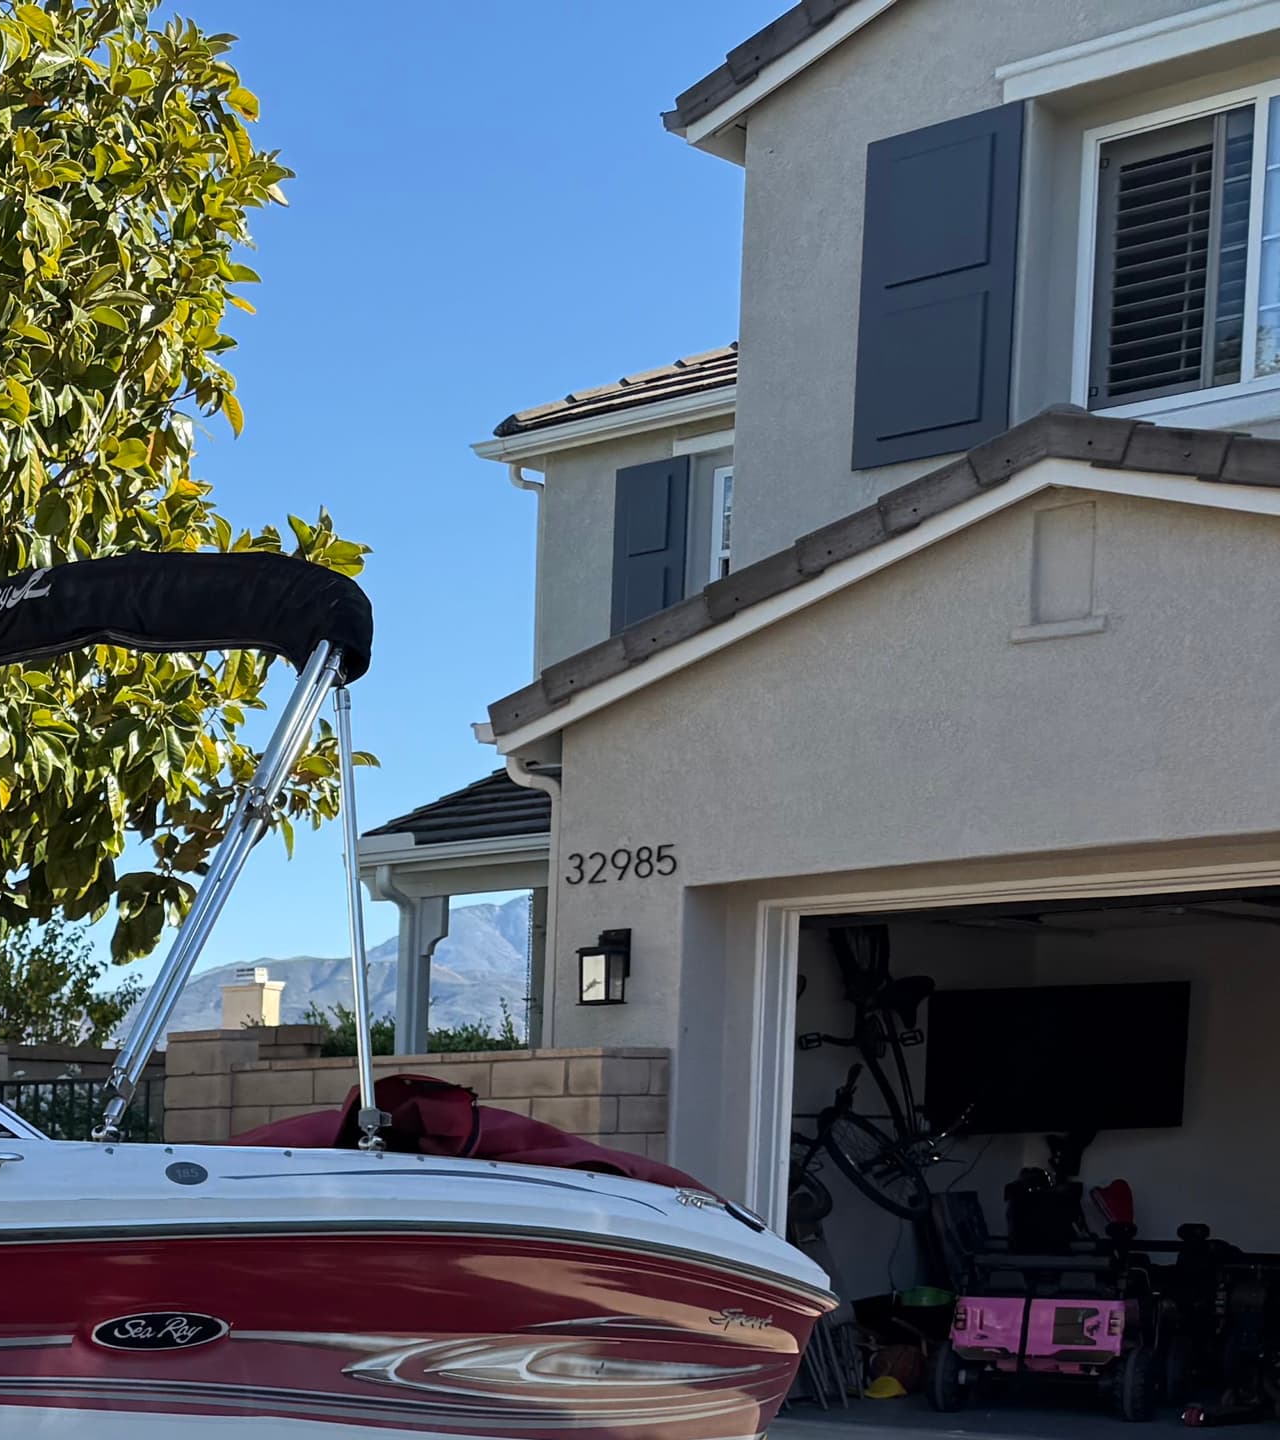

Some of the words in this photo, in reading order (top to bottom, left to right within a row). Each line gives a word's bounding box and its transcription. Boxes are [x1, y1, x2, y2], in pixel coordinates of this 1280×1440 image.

[565, 843, 678, 885] 32985
[175, 1167, 199, 1179] 185
[113, 1319, 156, 1339] Sea
[156, 1316, 203, 1344] Ray
